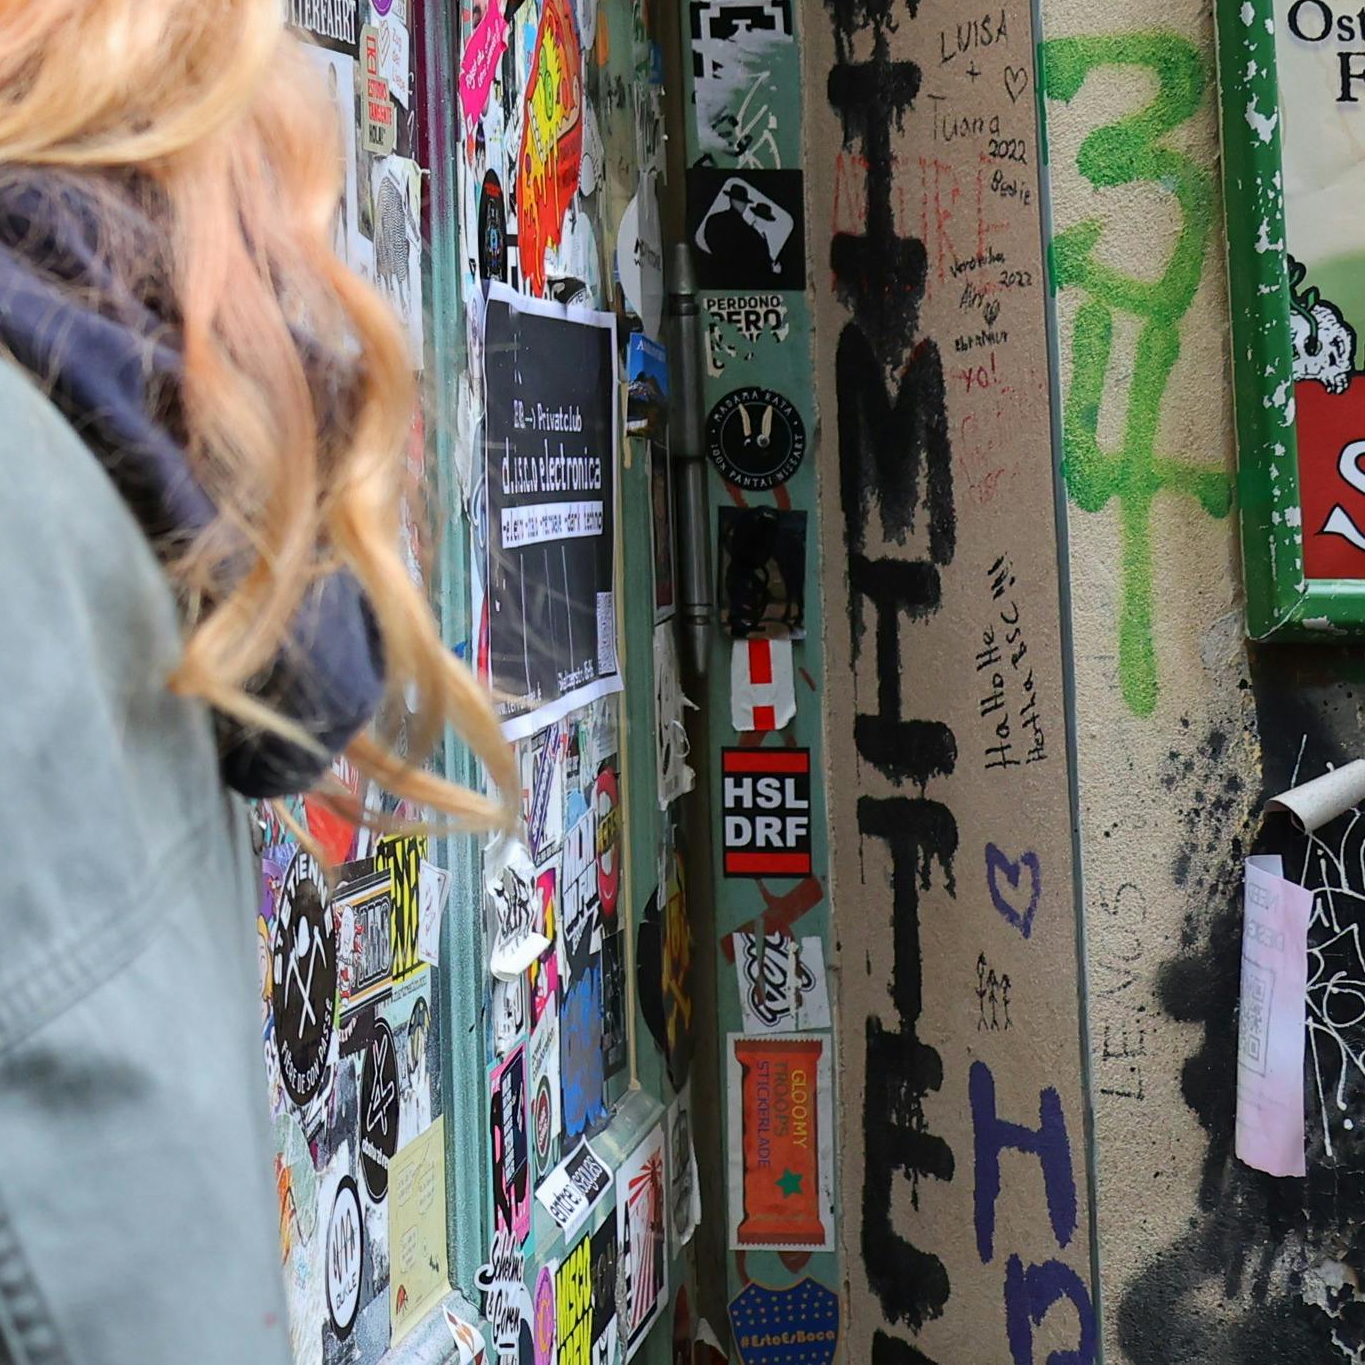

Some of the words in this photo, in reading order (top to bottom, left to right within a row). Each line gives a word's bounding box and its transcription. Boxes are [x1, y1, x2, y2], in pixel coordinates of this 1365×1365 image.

[940, 10, 1010, 64] LUISA
[988, 138, 1028, 166] 2022
[707, 295, 782, 312] PERDONO
[537, 402, 584, 433] Privatclub
[713, 390, 760, 423] MADAMA
[539, 439, 602, 494] electronica
[723, 776, 810, 810] HSL
[724, 814, 810, 848] DRF
[756, 1060, 773, 1169] STICKERLADE
[772, 1061, 789, 1138] TROOPS
[791, 1068, 808, 1150] GLOOMY
[740, 1330, 836, 1348] #EstoEsBoca
